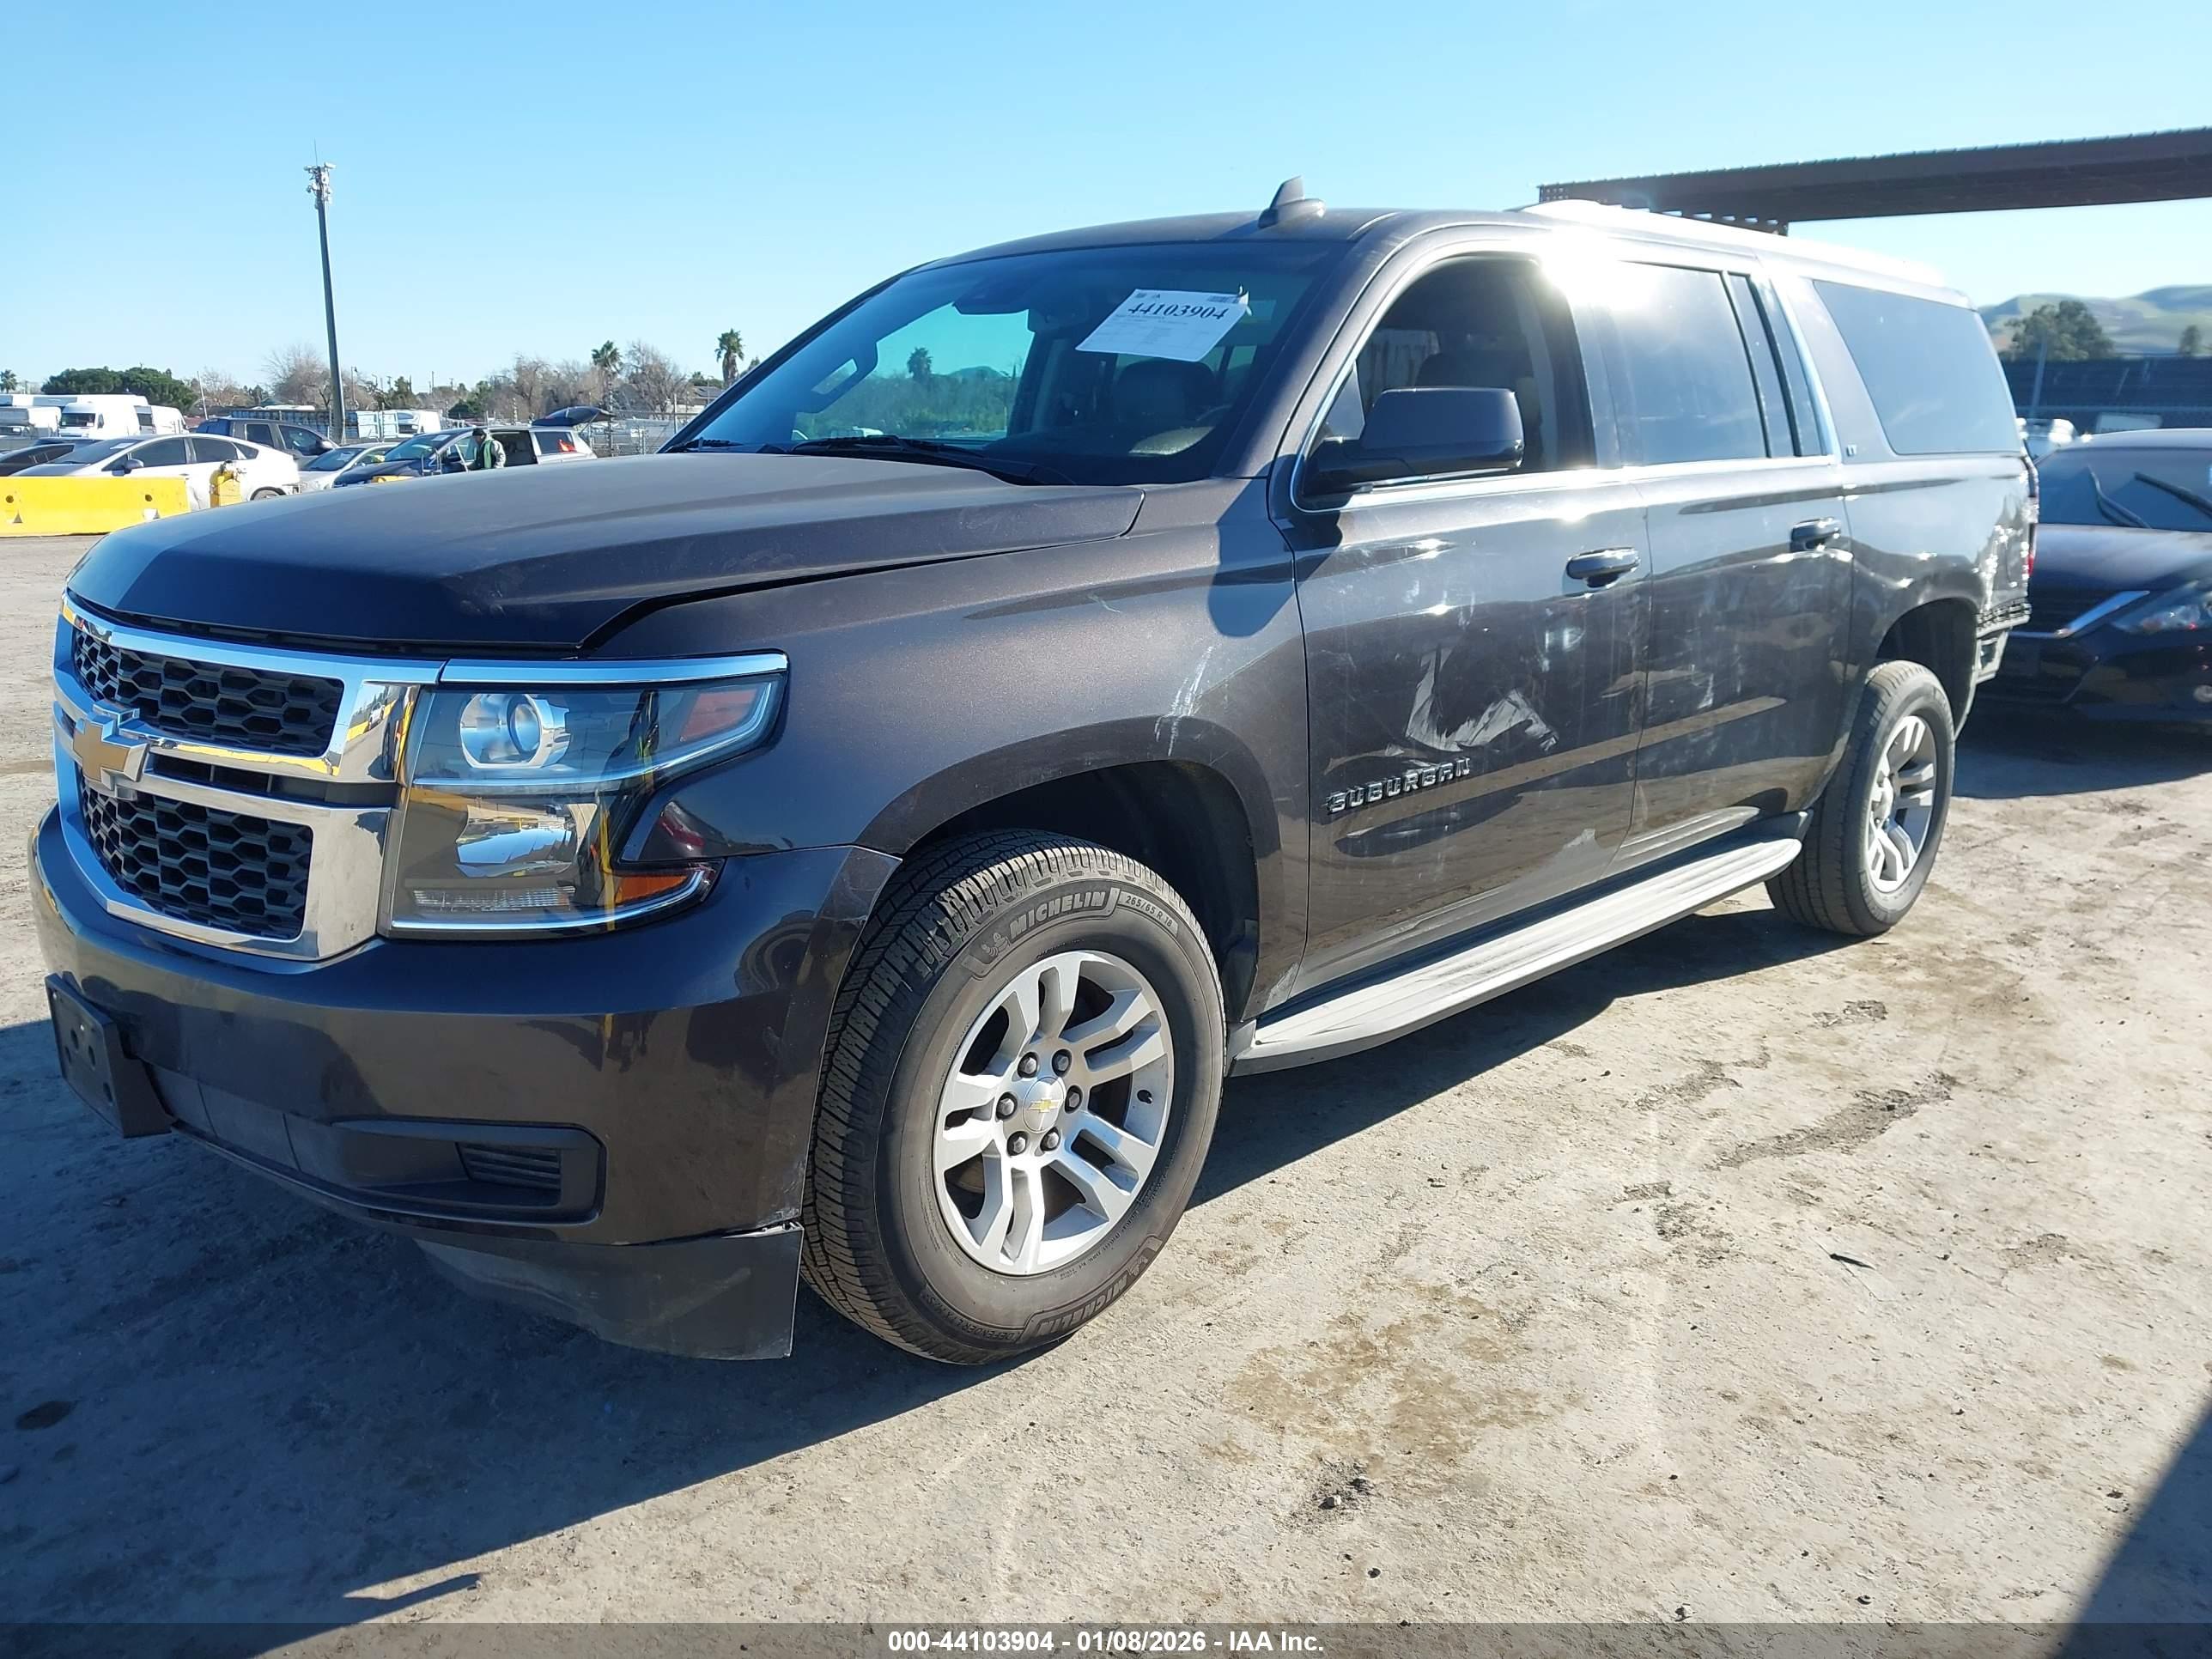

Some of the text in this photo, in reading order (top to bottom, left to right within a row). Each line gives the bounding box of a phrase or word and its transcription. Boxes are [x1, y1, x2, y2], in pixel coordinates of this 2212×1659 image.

[1127, 302, 1231, 320] 44103904
[1326, 757, 1471, 815] SUBURBAN
[1009, 890, 1106, 940] MICHELIN
[1125, 895, 1173, 927] 265/65 R 18
[1036, 1273, 1127, 1337] MICHELIN
[963, 1323, 1014, 1340] DEFENDER
